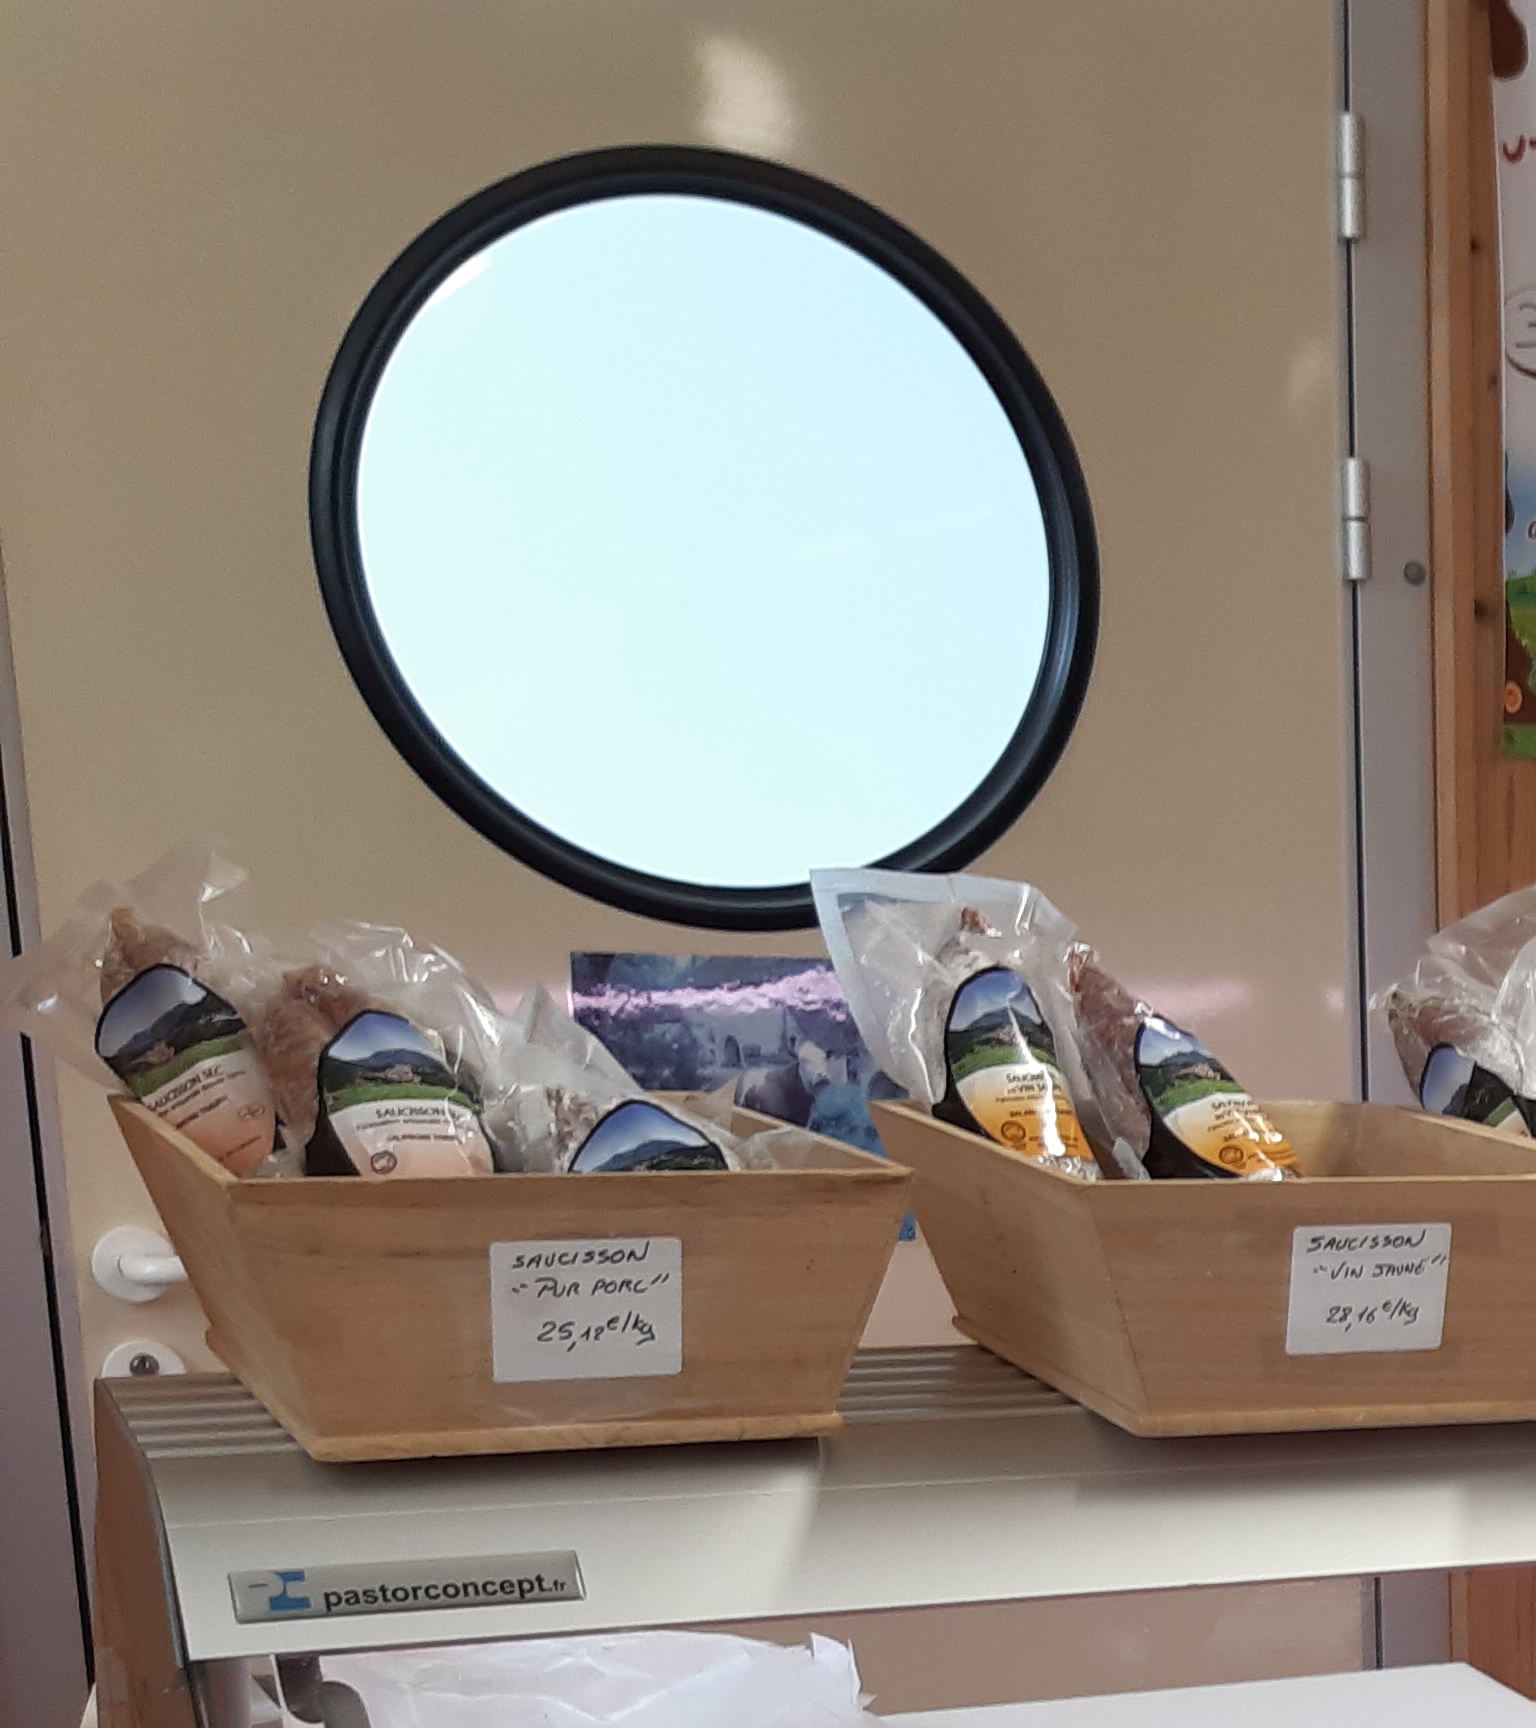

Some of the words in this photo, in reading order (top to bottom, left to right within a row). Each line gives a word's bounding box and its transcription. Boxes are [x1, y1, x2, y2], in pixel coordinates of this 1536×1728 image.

[511, 1240, 650, 1269] SAUCISSON
[1306, 1228, 1427, 1253] SAUCISSON
[323, 1571, 568, 1613] pastorconcept.fr
